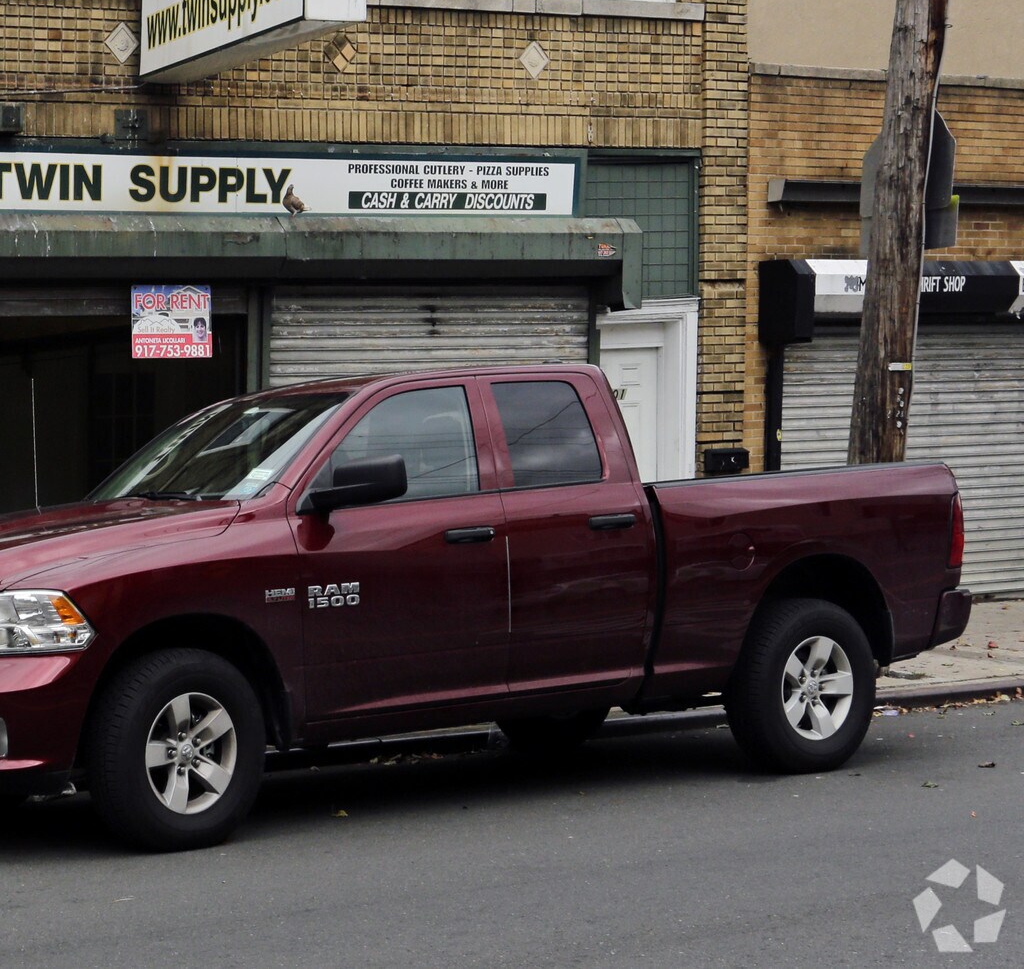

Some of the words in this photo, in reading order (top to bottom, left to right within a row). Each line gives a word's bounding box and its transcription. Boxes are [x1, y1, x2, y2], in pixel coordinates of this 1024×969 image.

[348, 164, 419, 175] PROFESSIONAL
[423, 165, 465, 176] CUTLERY
[476, 166, 502, 176] PIZZA
[505, 166, 549, 177] SUPPLIES
[128, 164, 291, 204] SUPPLY
[391, 179, 424, 189] COFFEE
[427, 179, 467, 189] MAKERS
[471, 180, 478, 190] &
[481, 180, 508, 190] MORE
[361, 192, 396, 209] CASH
[400, 193, 410, 209] &
[414, 193, 457, 209] CARRY
[465, 193, 535, 210] DISCOUNTS
[921, 276, 941, 292] RIFT
[943, 276, 966, 292] SHOP
[135, 293, 166, 309] FOR
[170, 294, 209, 309] RENT
[135, 345, 210, 357] 917-753-9881
[265, 588, 295, 597] HEMI
[307, 582, 360, 597] RAM
[308, 594, 360, 609] 1500
